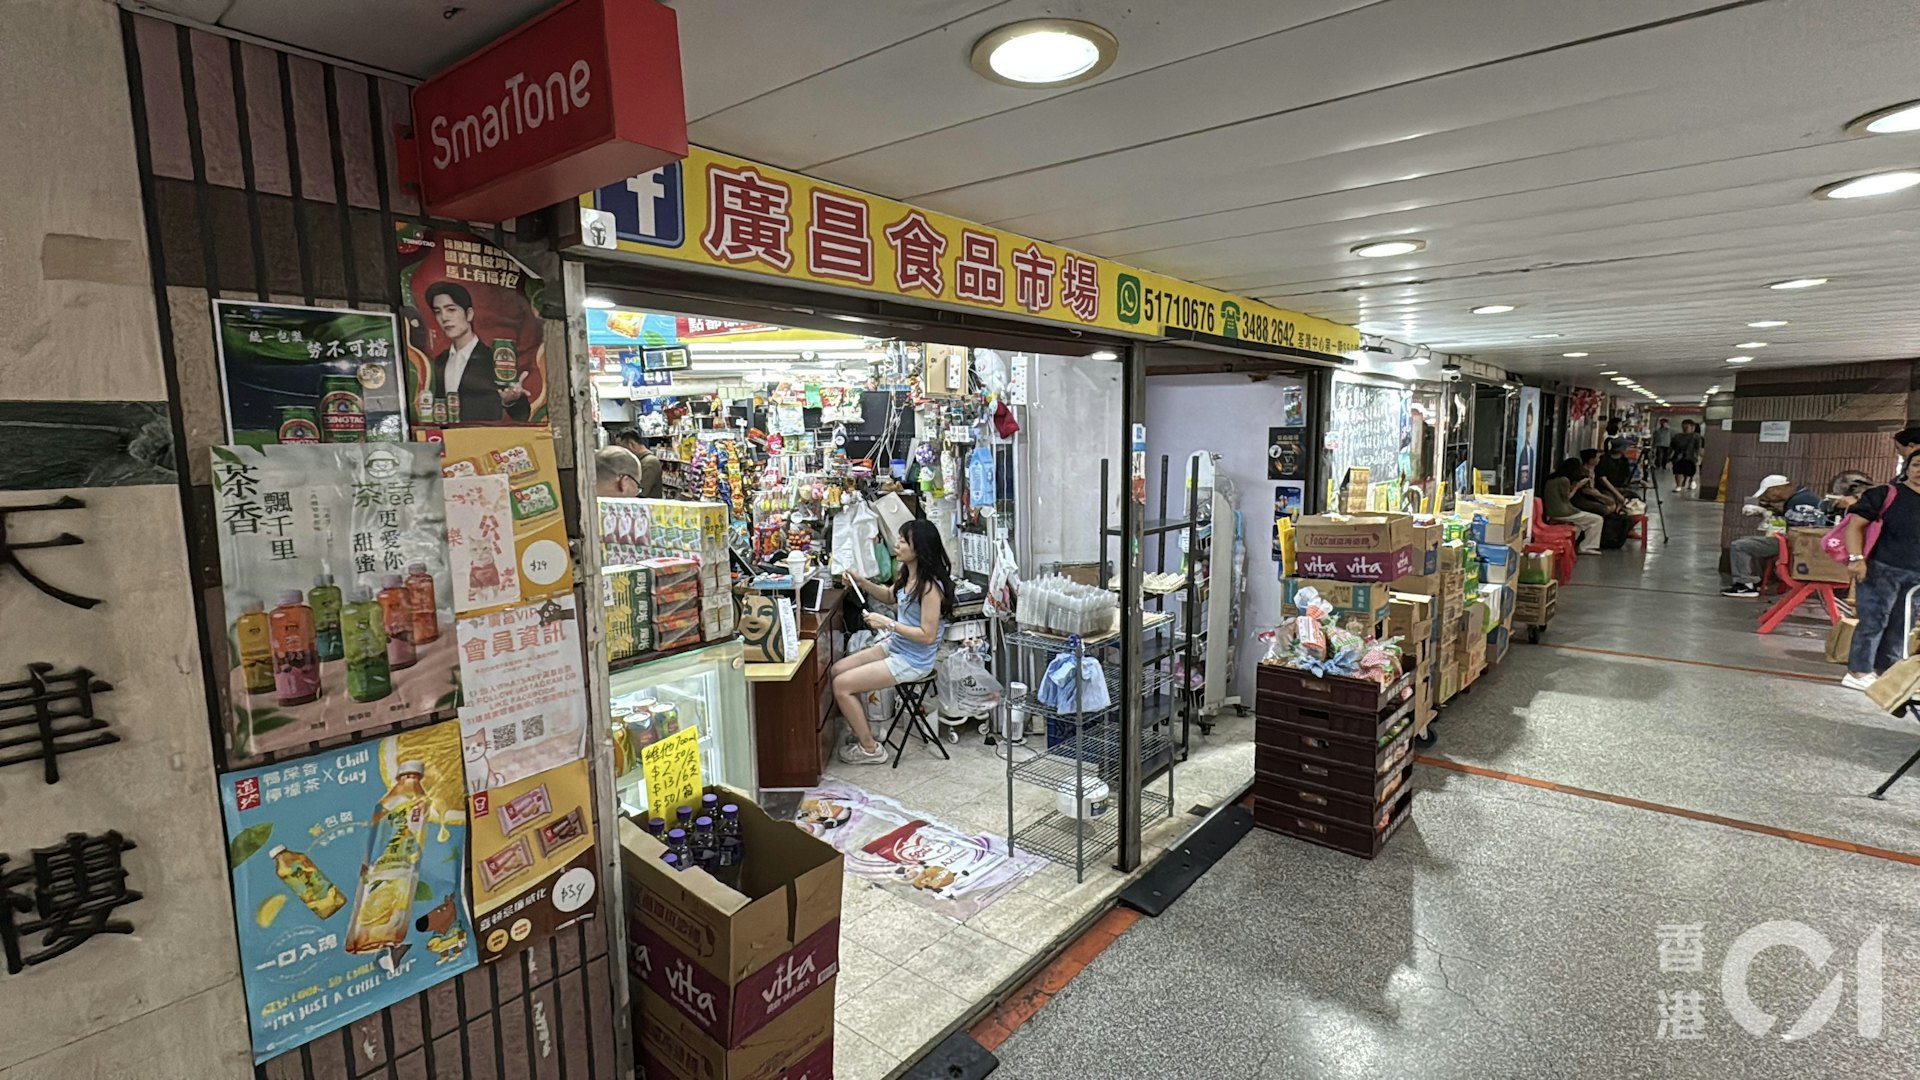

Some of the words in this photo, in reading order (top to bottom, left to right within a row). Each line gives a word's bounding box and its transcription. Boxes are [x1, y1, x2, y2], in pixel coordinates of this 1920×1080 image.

[431, 57, 592, 171] SmarTone
[701, 162, 1100, 321] 廣昌食品市場
[1144, 288, 1215, 332] 51710676
[1242, 311, 1269, 342] 3488
[1271, 318, 1295, 347] 2642
[306, 338, 390, 359] 勢不可擋
[219, 463, 263, 536] 茶香
[260, 491, 298, 562] 飄千里
[377, 509, 405, 573] 更愛你
[353, 532, 377, 575] 甜蜜
[1304, 556, 1338, 573] vita
[1346, 556, 1383, 574] vita
[462, 620, 567, 663] 會員資訊
[335, 749, 370, 770] Chill
[337, 769, 367, 785] Guy
[255, 933, 338, 971] 一口入魂
[665, 958, 717, 1022] vita
[762, 951, 816, 1002] vita
[299, 994, 330, 1021] JUST
[333, 990, 343, 1005] A
[346, 980, 381, 998] CHILL
